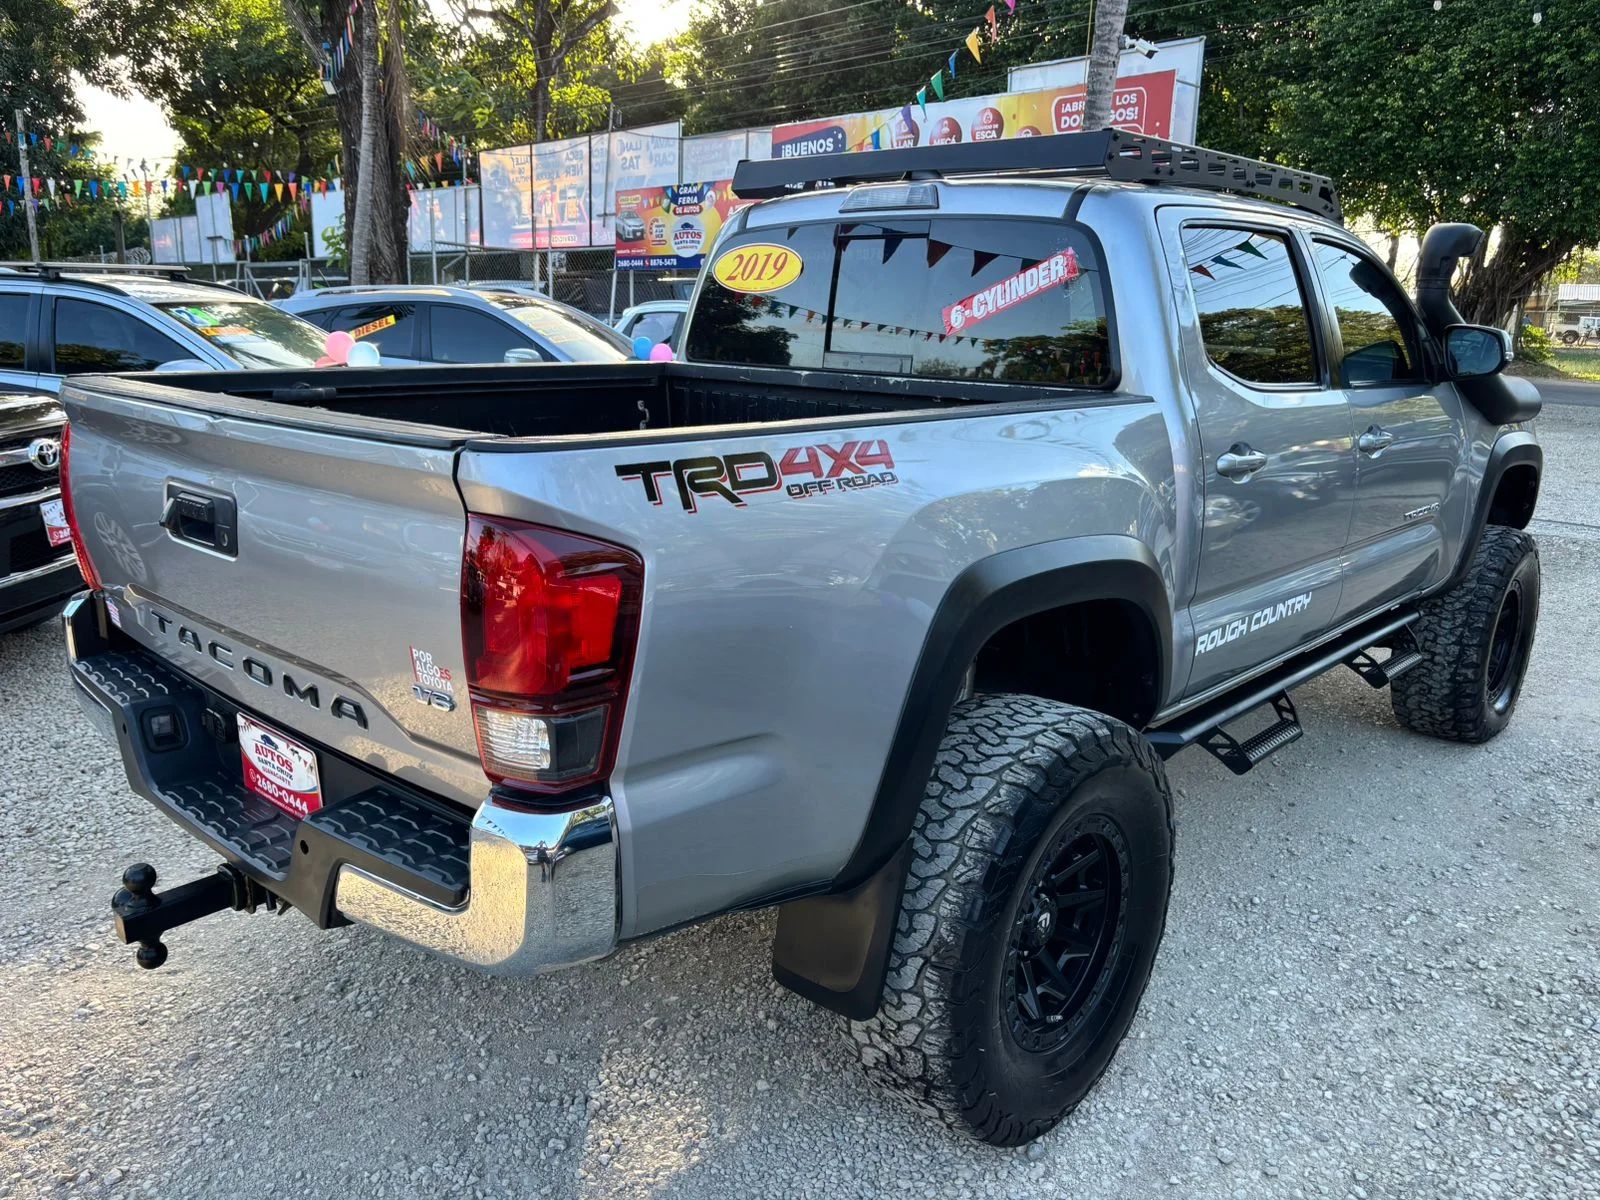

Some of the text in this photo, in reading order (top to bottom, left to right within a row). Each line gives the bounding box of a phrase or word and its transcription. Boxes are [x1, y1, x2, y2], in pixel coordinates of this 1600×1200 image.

[1116, 93, 1137, 106] LOS
[975, 130, 997, 140] ESCA
[781, 138, 834, 158] ¡BUENOS
[678, 186, 698, 195] GRAN
[678, 195, 698, 205] FERIA
[684, 206, 700, 214] AUTOS
[674, 231, 702, 241] AUTOS
[617, 260, 644, 268] 2680-0444
[725, 251, 788, 281] 2019
[950, 254, 1067, 329] 6-CYLINDER
[355, 318, 391, 338] DIESEL
[614, 439, 895, 513] TRD 4X4
[786, 471, 899, 499] OFF ROAD
[1195, 592, 1312, 656] ROUGH COUNTRY
[412, 648, 433, 665] POR
[150, 610, 369, 731] TACOMA
[416, 672, 454, 693] TOYOTA
[255, 742, 294, 773] AUTOS
[257, 756, 294, 781] SANTA CRUZ
[256, 774, 309, 815] 2680-0444
